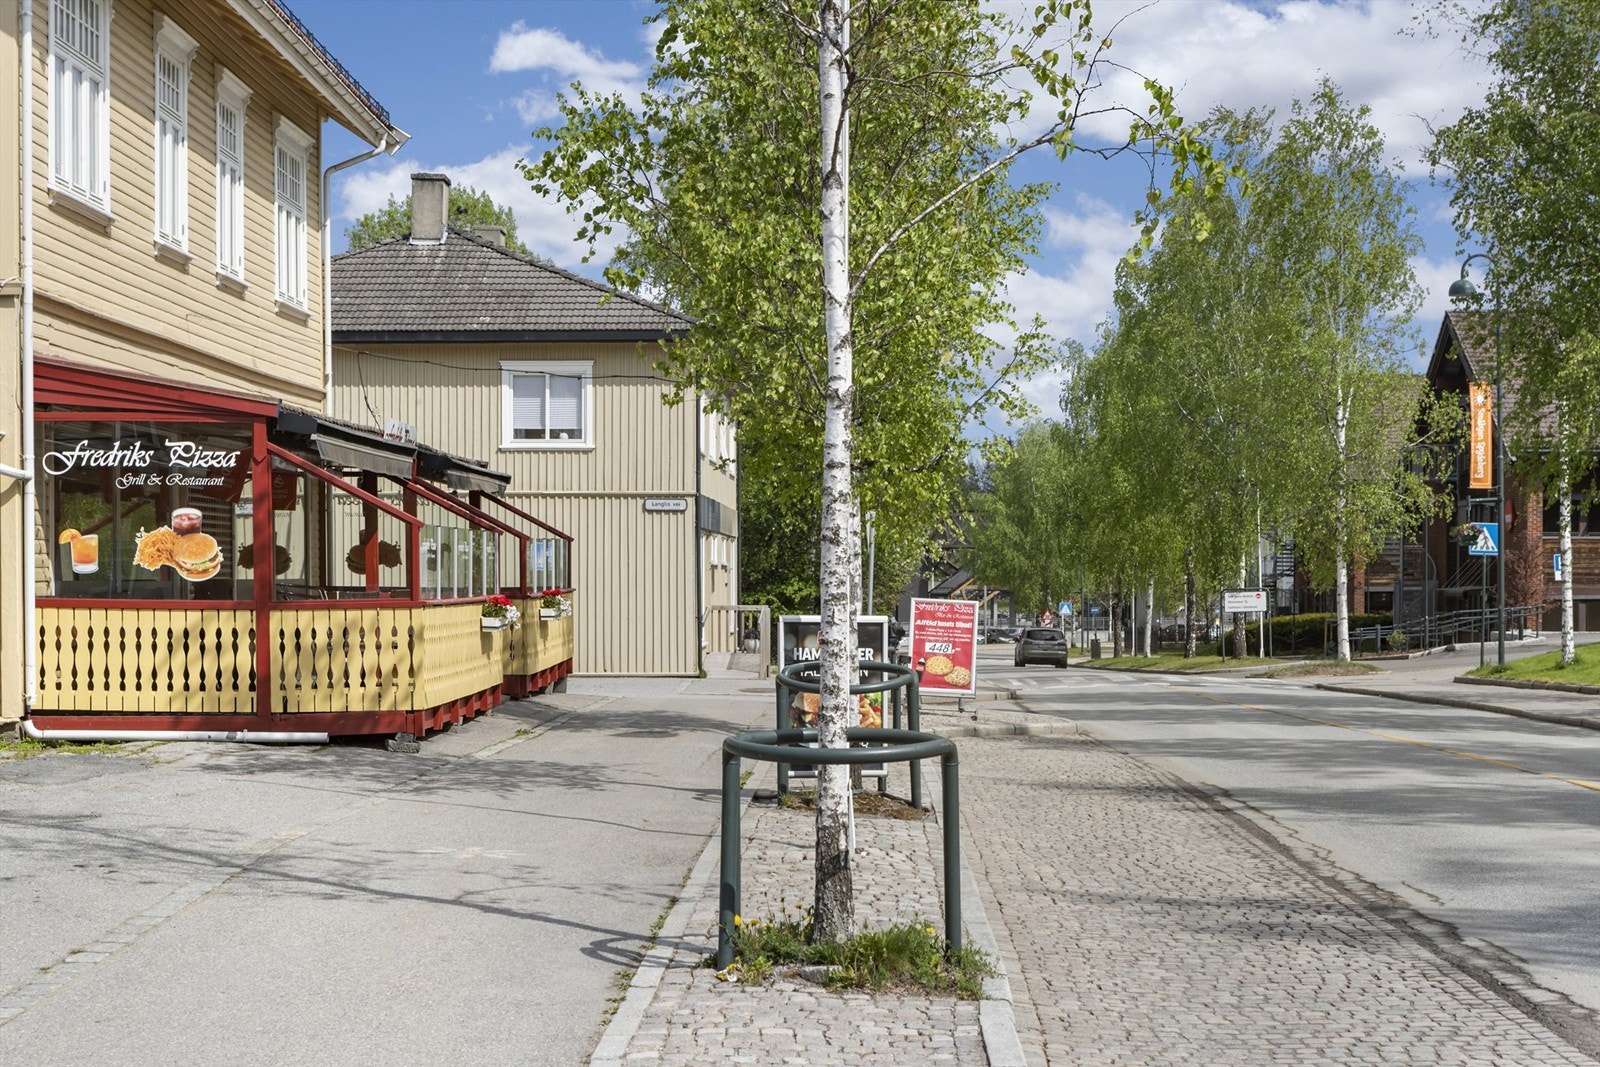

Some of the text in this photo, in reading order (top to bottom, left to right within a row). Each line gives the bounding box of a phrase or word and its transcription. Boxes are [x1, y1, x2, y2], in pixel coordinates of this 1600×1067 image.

[42, 438, 241, 475] Fredriks Pizza
[1475, 442, 1486, 478] Spydeberg
[115, 472, 145, 489] Grill
[147, 473, 163, 486] &
[166, 473, 225, 486] Restaurant
